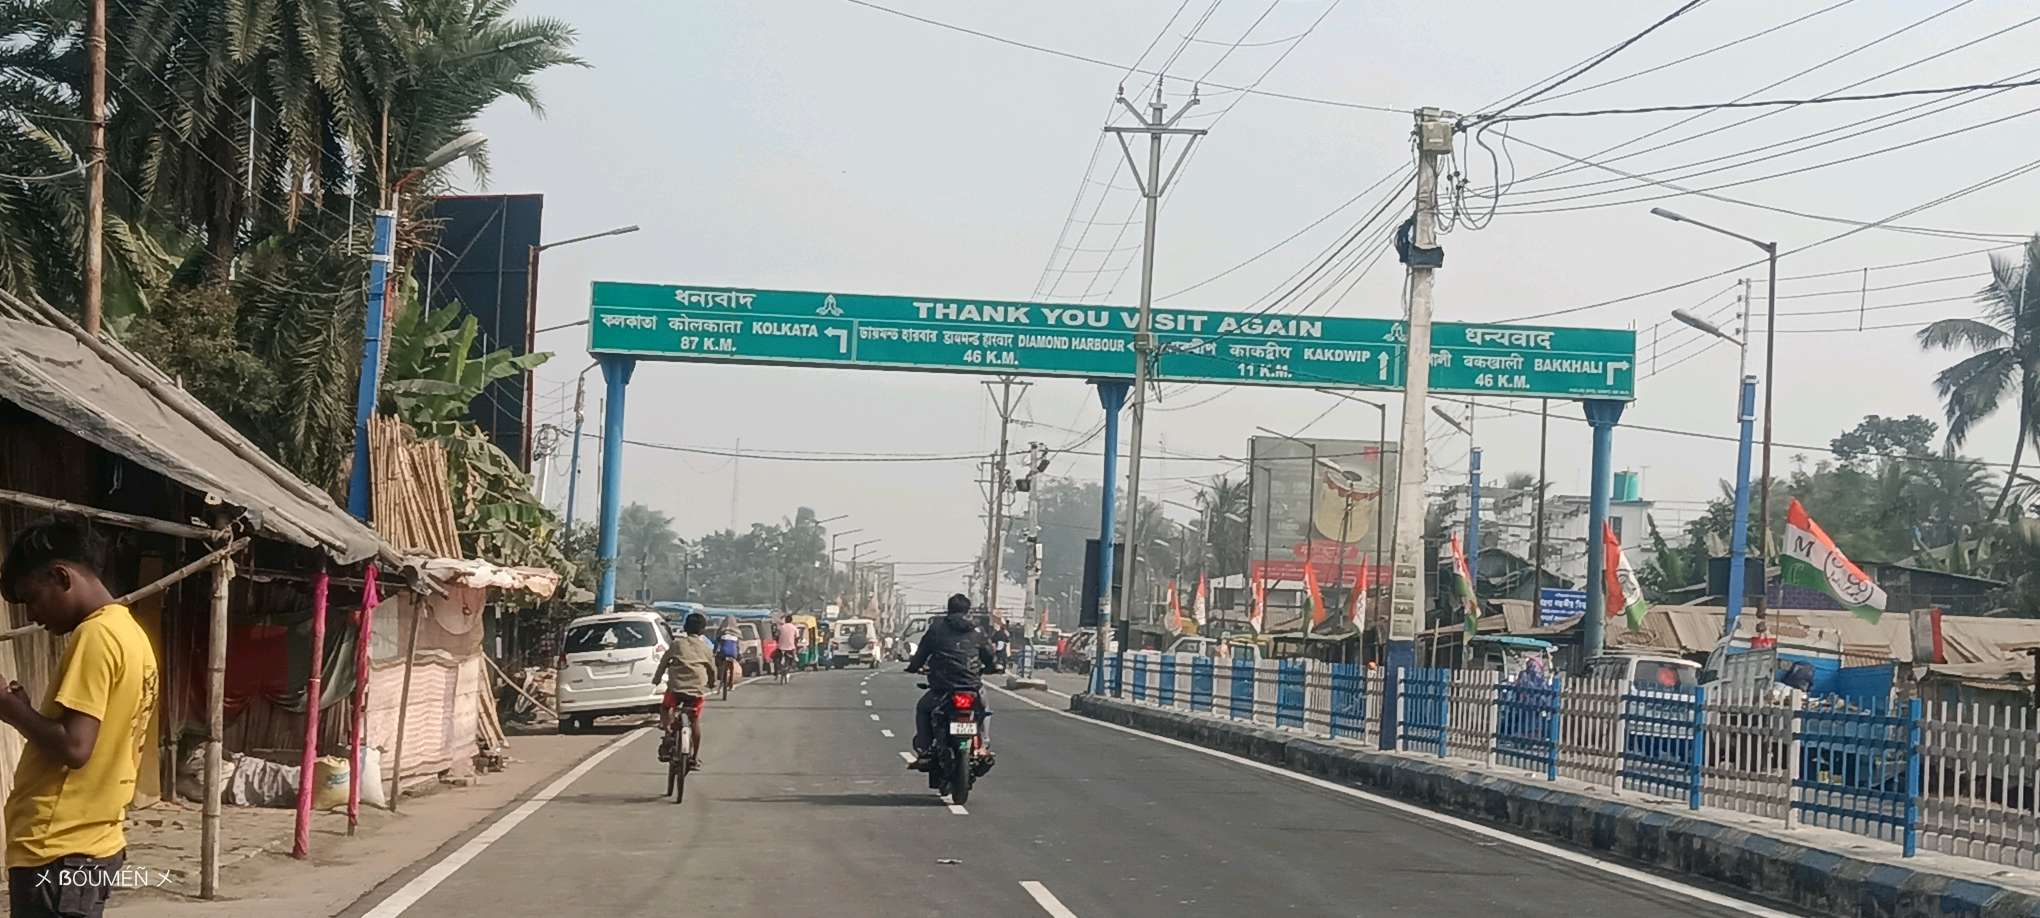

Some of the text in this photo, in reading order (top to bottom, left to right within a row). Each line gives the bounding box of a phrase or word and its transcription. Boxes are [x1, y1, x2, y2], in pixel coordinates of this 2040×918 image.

[674, 288, 756, 310] ধন্যবাদ
[600, 313, 819, 338] কলকাতা कोलकाता KOLKATA
[913, 301, 1031, 324] THANK
[1041, 307, 1109, 327] YOU
[1216, 316, 1322, 338] AGAIN
[680, 336, 737, 352] 87 K.M.
[1018, 335, 1069, 351] DIAMOND
[1071, 337, 1125, 353] HARBOUR
[1465, 327, 1555, 350] धन्यवाद
[963, 349, 1019, 366] 46 K.M.
[1229, 341, 1293, 360] काकद्वीप
[1303, 347, 1371, 363] KAKDWIP
[1237, 363, 1292, 379] 11 K.M.
[1534, 357, 1603, 374] BAKKHALI
[1475, 373, 1530, 390] 46 K.M.
